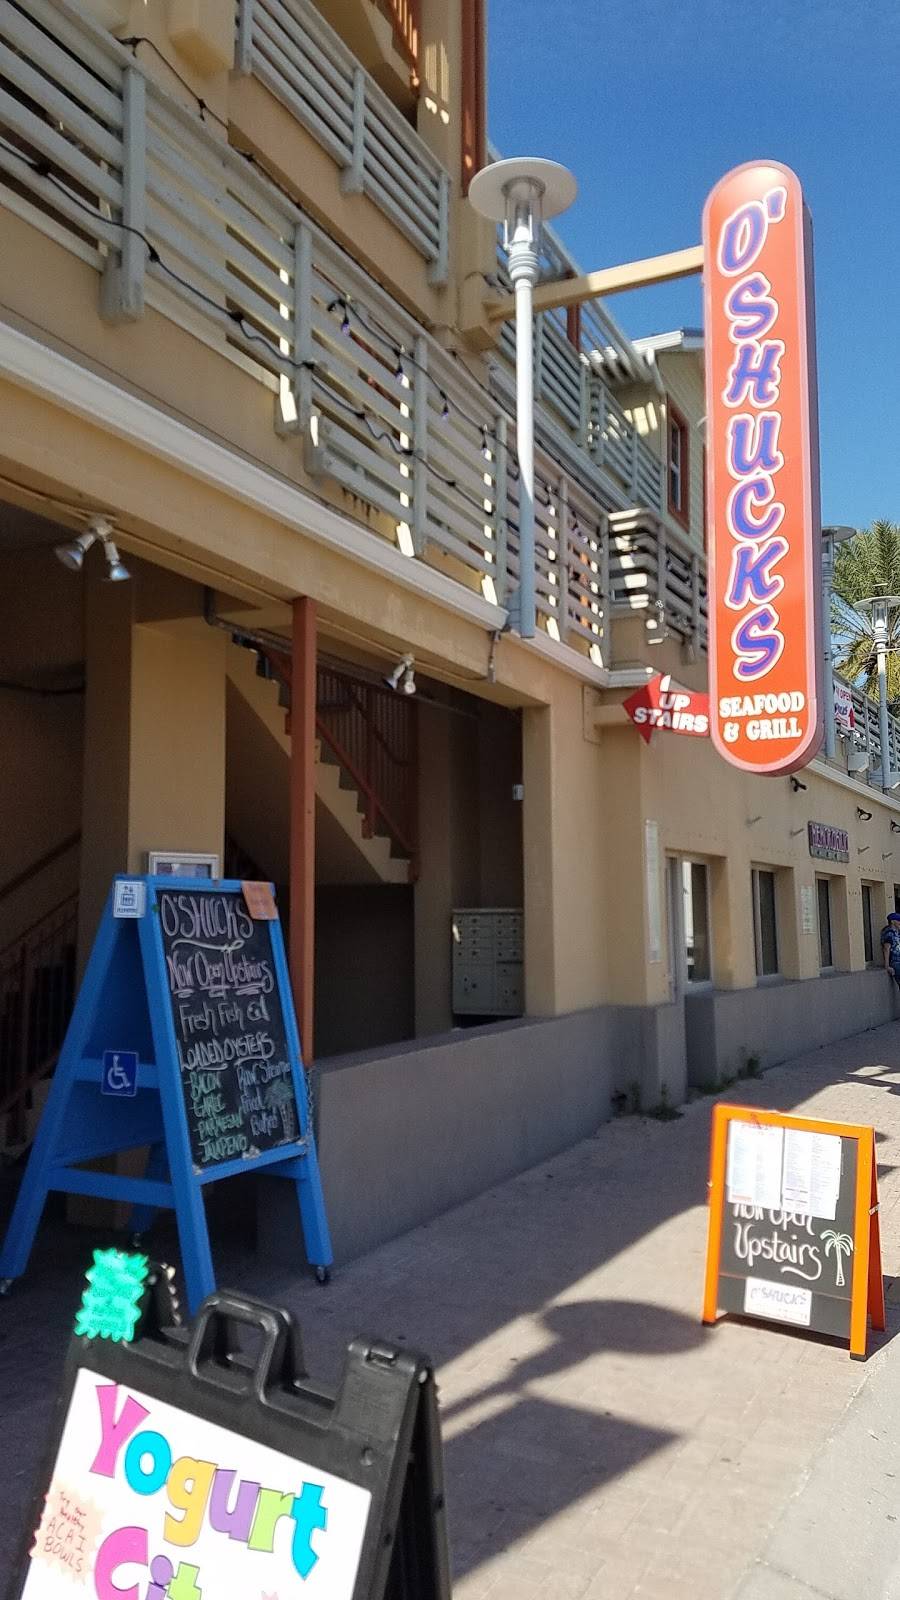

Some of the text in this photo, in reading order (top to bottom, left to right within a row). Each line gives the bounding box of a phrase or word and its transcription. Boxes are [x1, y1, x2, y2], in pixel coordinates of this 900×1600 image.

[717, 186, 789, 682] O'SHUCKS
[633, 706, 709, 733] STAIRS
[659, 693, 691, 711] UP
[719, 691, 805, 718] SEAFOOD
[723, 717, 802, 743] & GRILL
[223, 952, 274, 993] Upstairs
[179, 1001, 219, 1042] Fresh
[217, 1001, 245, 1031] Fish
[223, 1031, 275, 1060] OYSTERS
[734, 1223, 822, 1280] Upstairs
[89, 1382, 328, 1580] Yogurt
[43, 1536, 83, 1573] BOWLS
